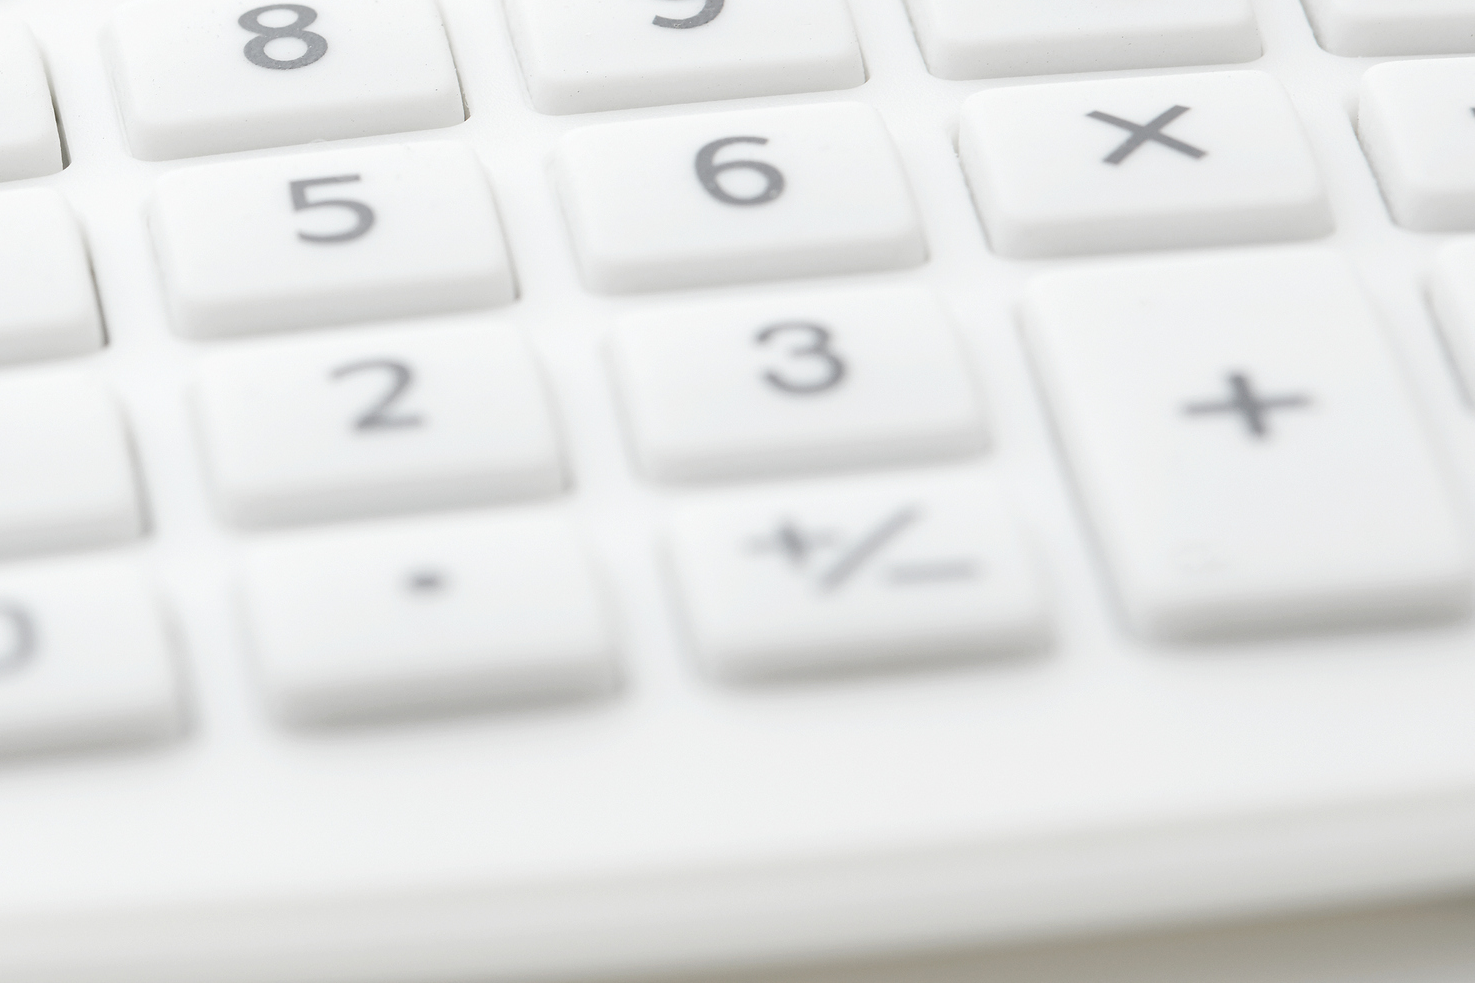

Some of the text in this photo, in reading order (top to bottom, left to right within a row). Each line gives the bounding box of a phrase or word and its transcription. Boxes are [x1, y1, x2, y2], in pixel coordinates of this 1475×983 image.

[236, 1, 331, 74] 8
[287, 172, 379, 247] 5
[692, 134, 788, 210] 6
[329, 356, 426, 436] 2
[755, 321, 850, 399] 3
[1181, 367, 1311, 443] +
